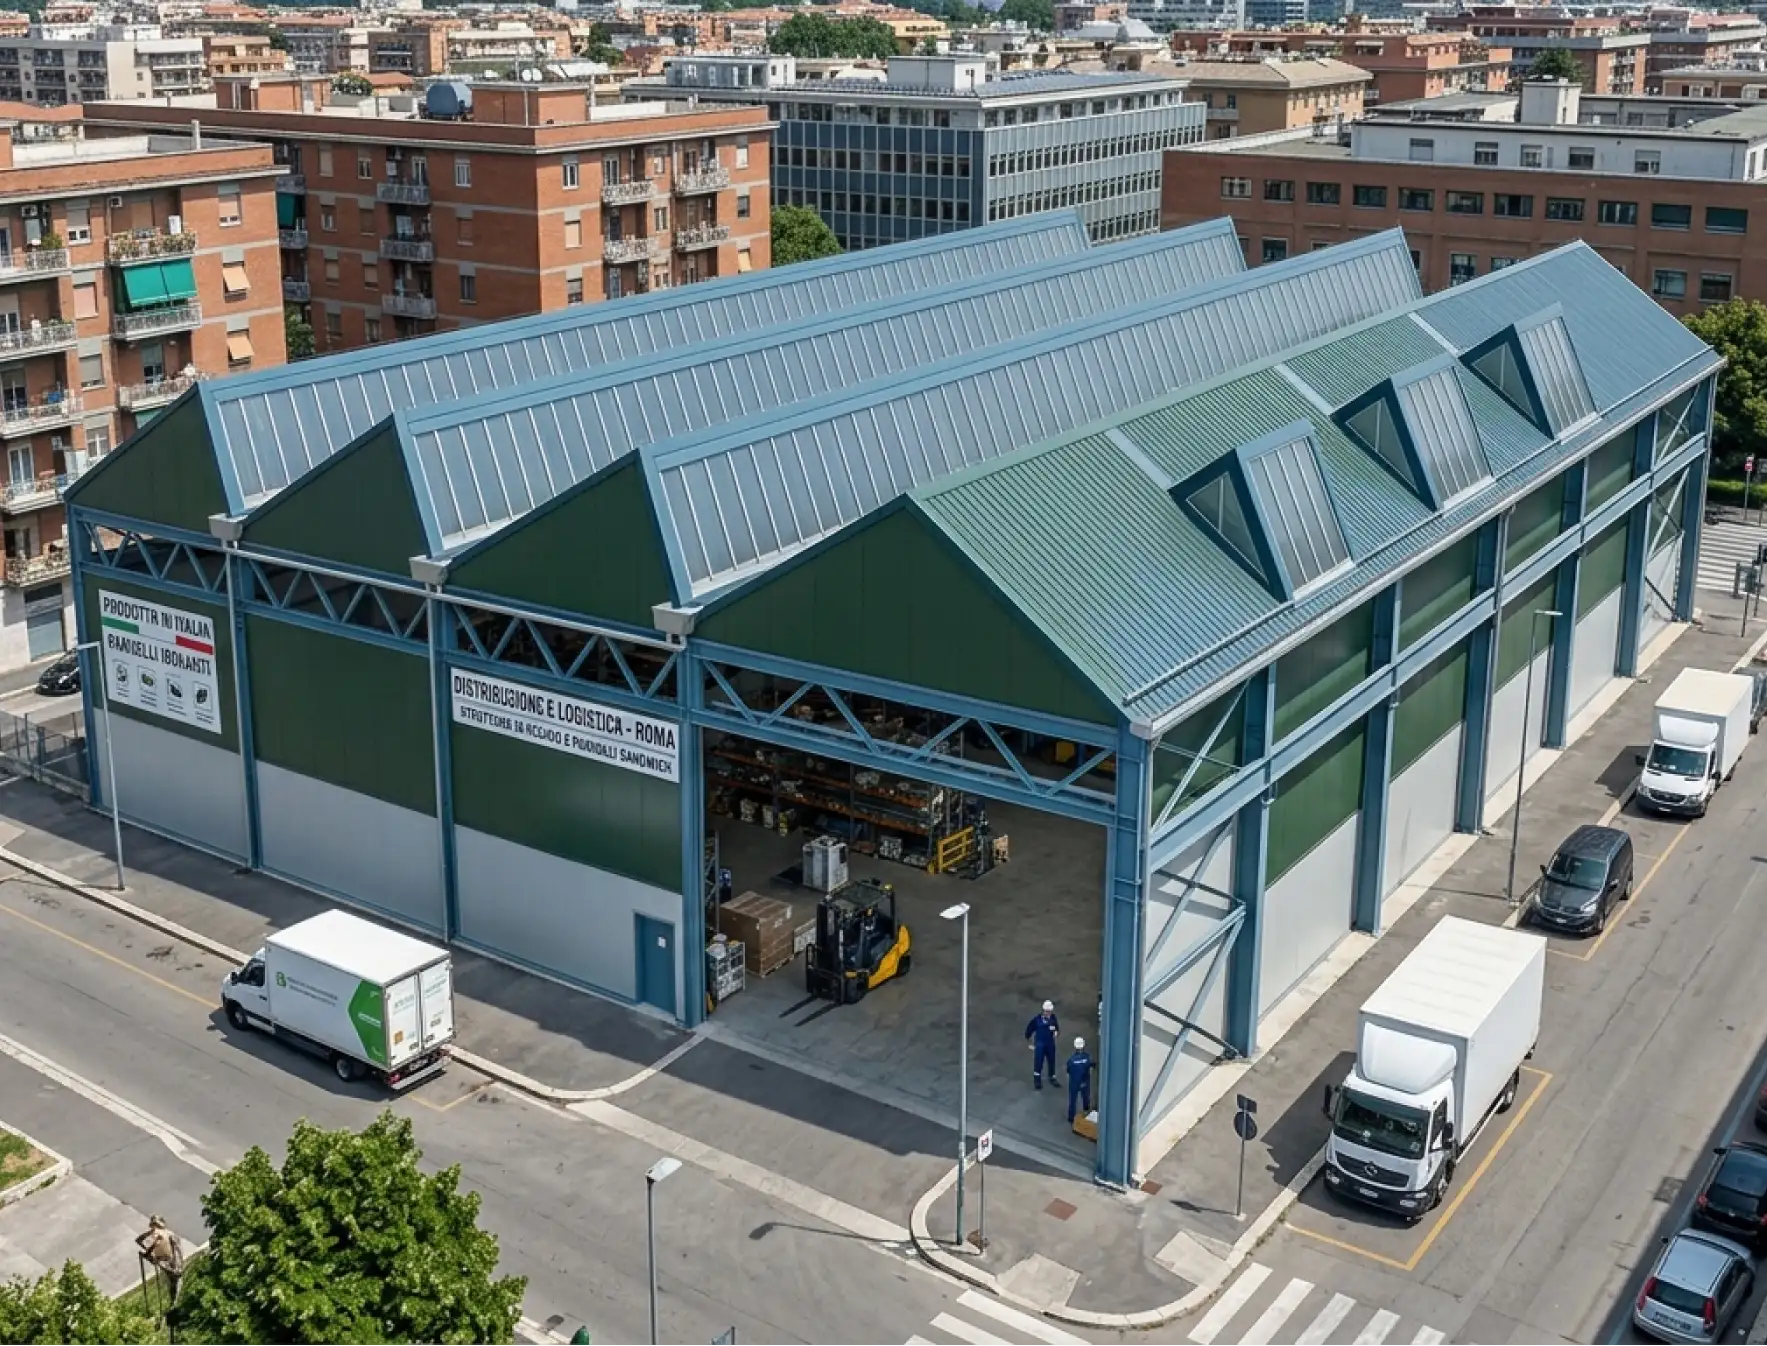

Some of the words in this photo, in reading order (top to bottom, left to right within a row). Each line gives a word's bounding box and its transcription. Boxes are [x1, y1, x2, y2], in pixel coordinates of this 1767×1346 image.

[546, 697, 554, 718] E
[558, 701, 623, 737] LOGISTICA
[635, 721, 675, 750] ROMA
[564, 733, 570, 747] E
